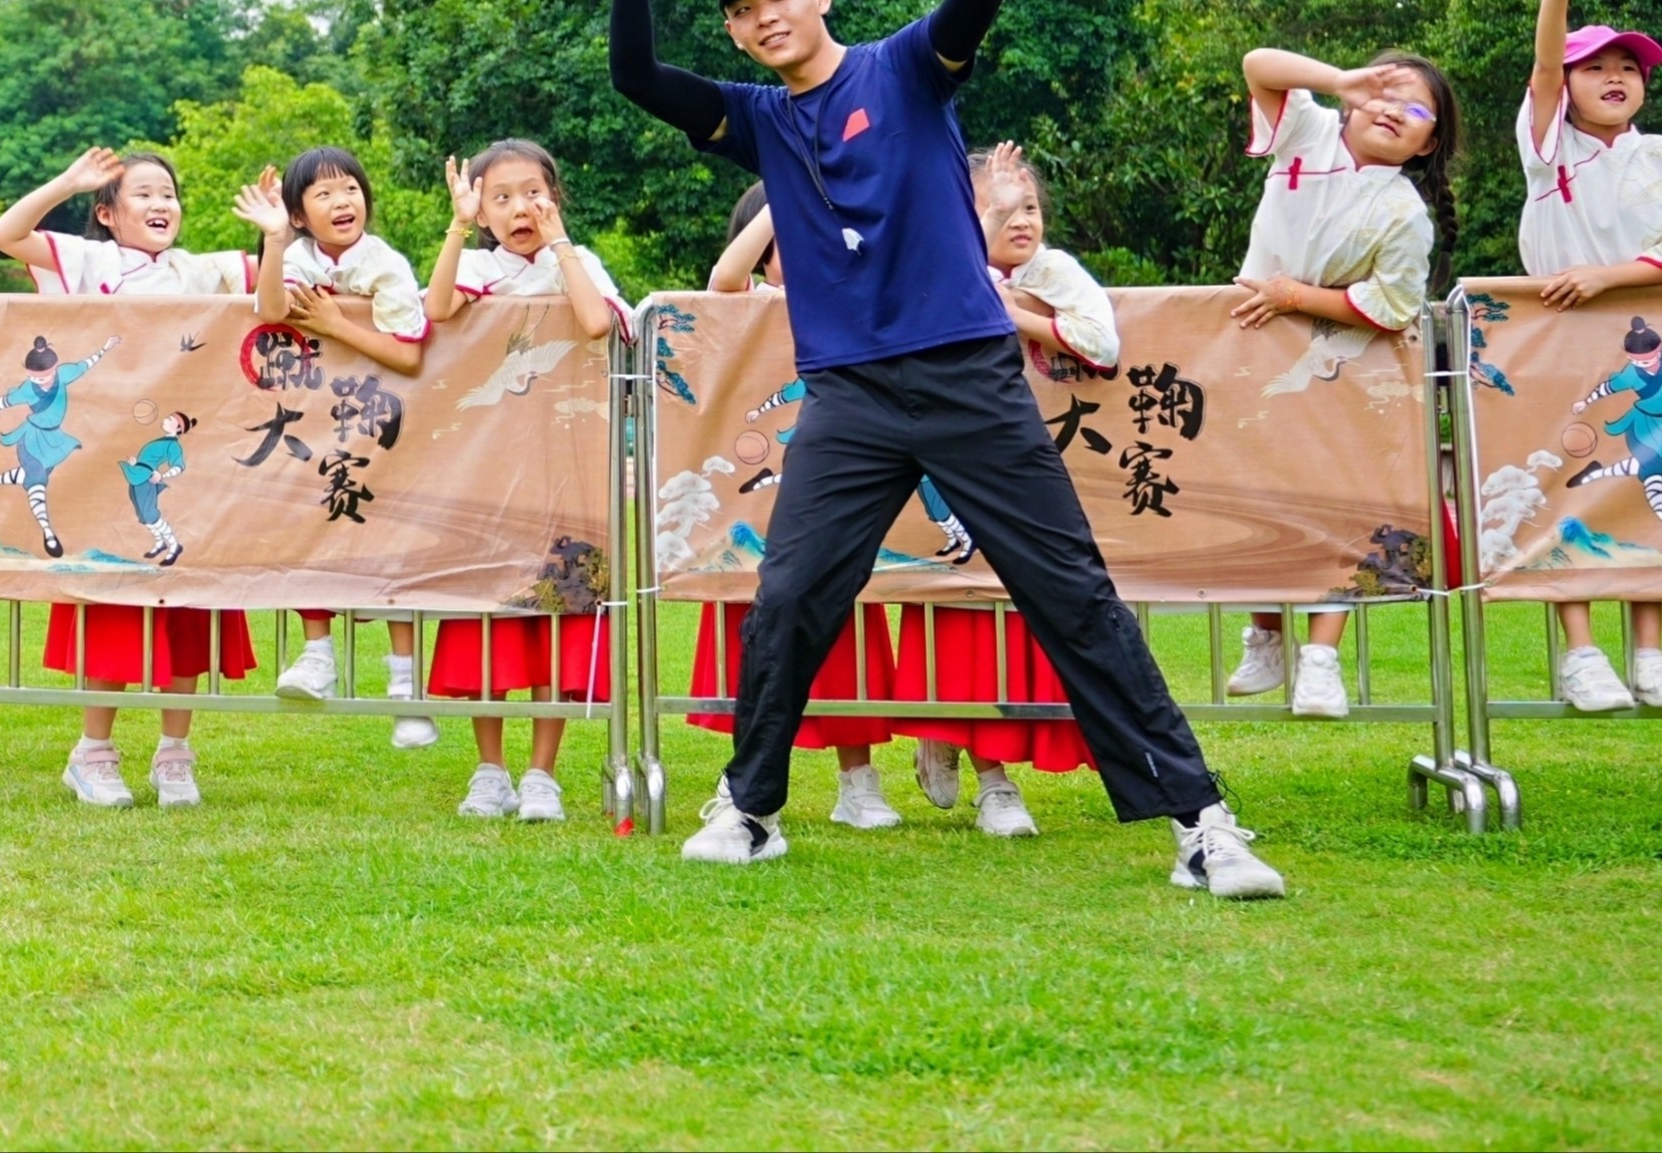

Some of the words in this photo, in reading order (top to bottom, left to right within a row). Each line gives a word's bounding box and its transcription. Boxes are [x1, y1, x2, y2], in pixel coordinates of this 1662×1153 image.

[255, 331, 404, 450] 蹴鞠
[231, 401, 375, 523] 大赛
[1044, 393, 1181, 517] 大赛
